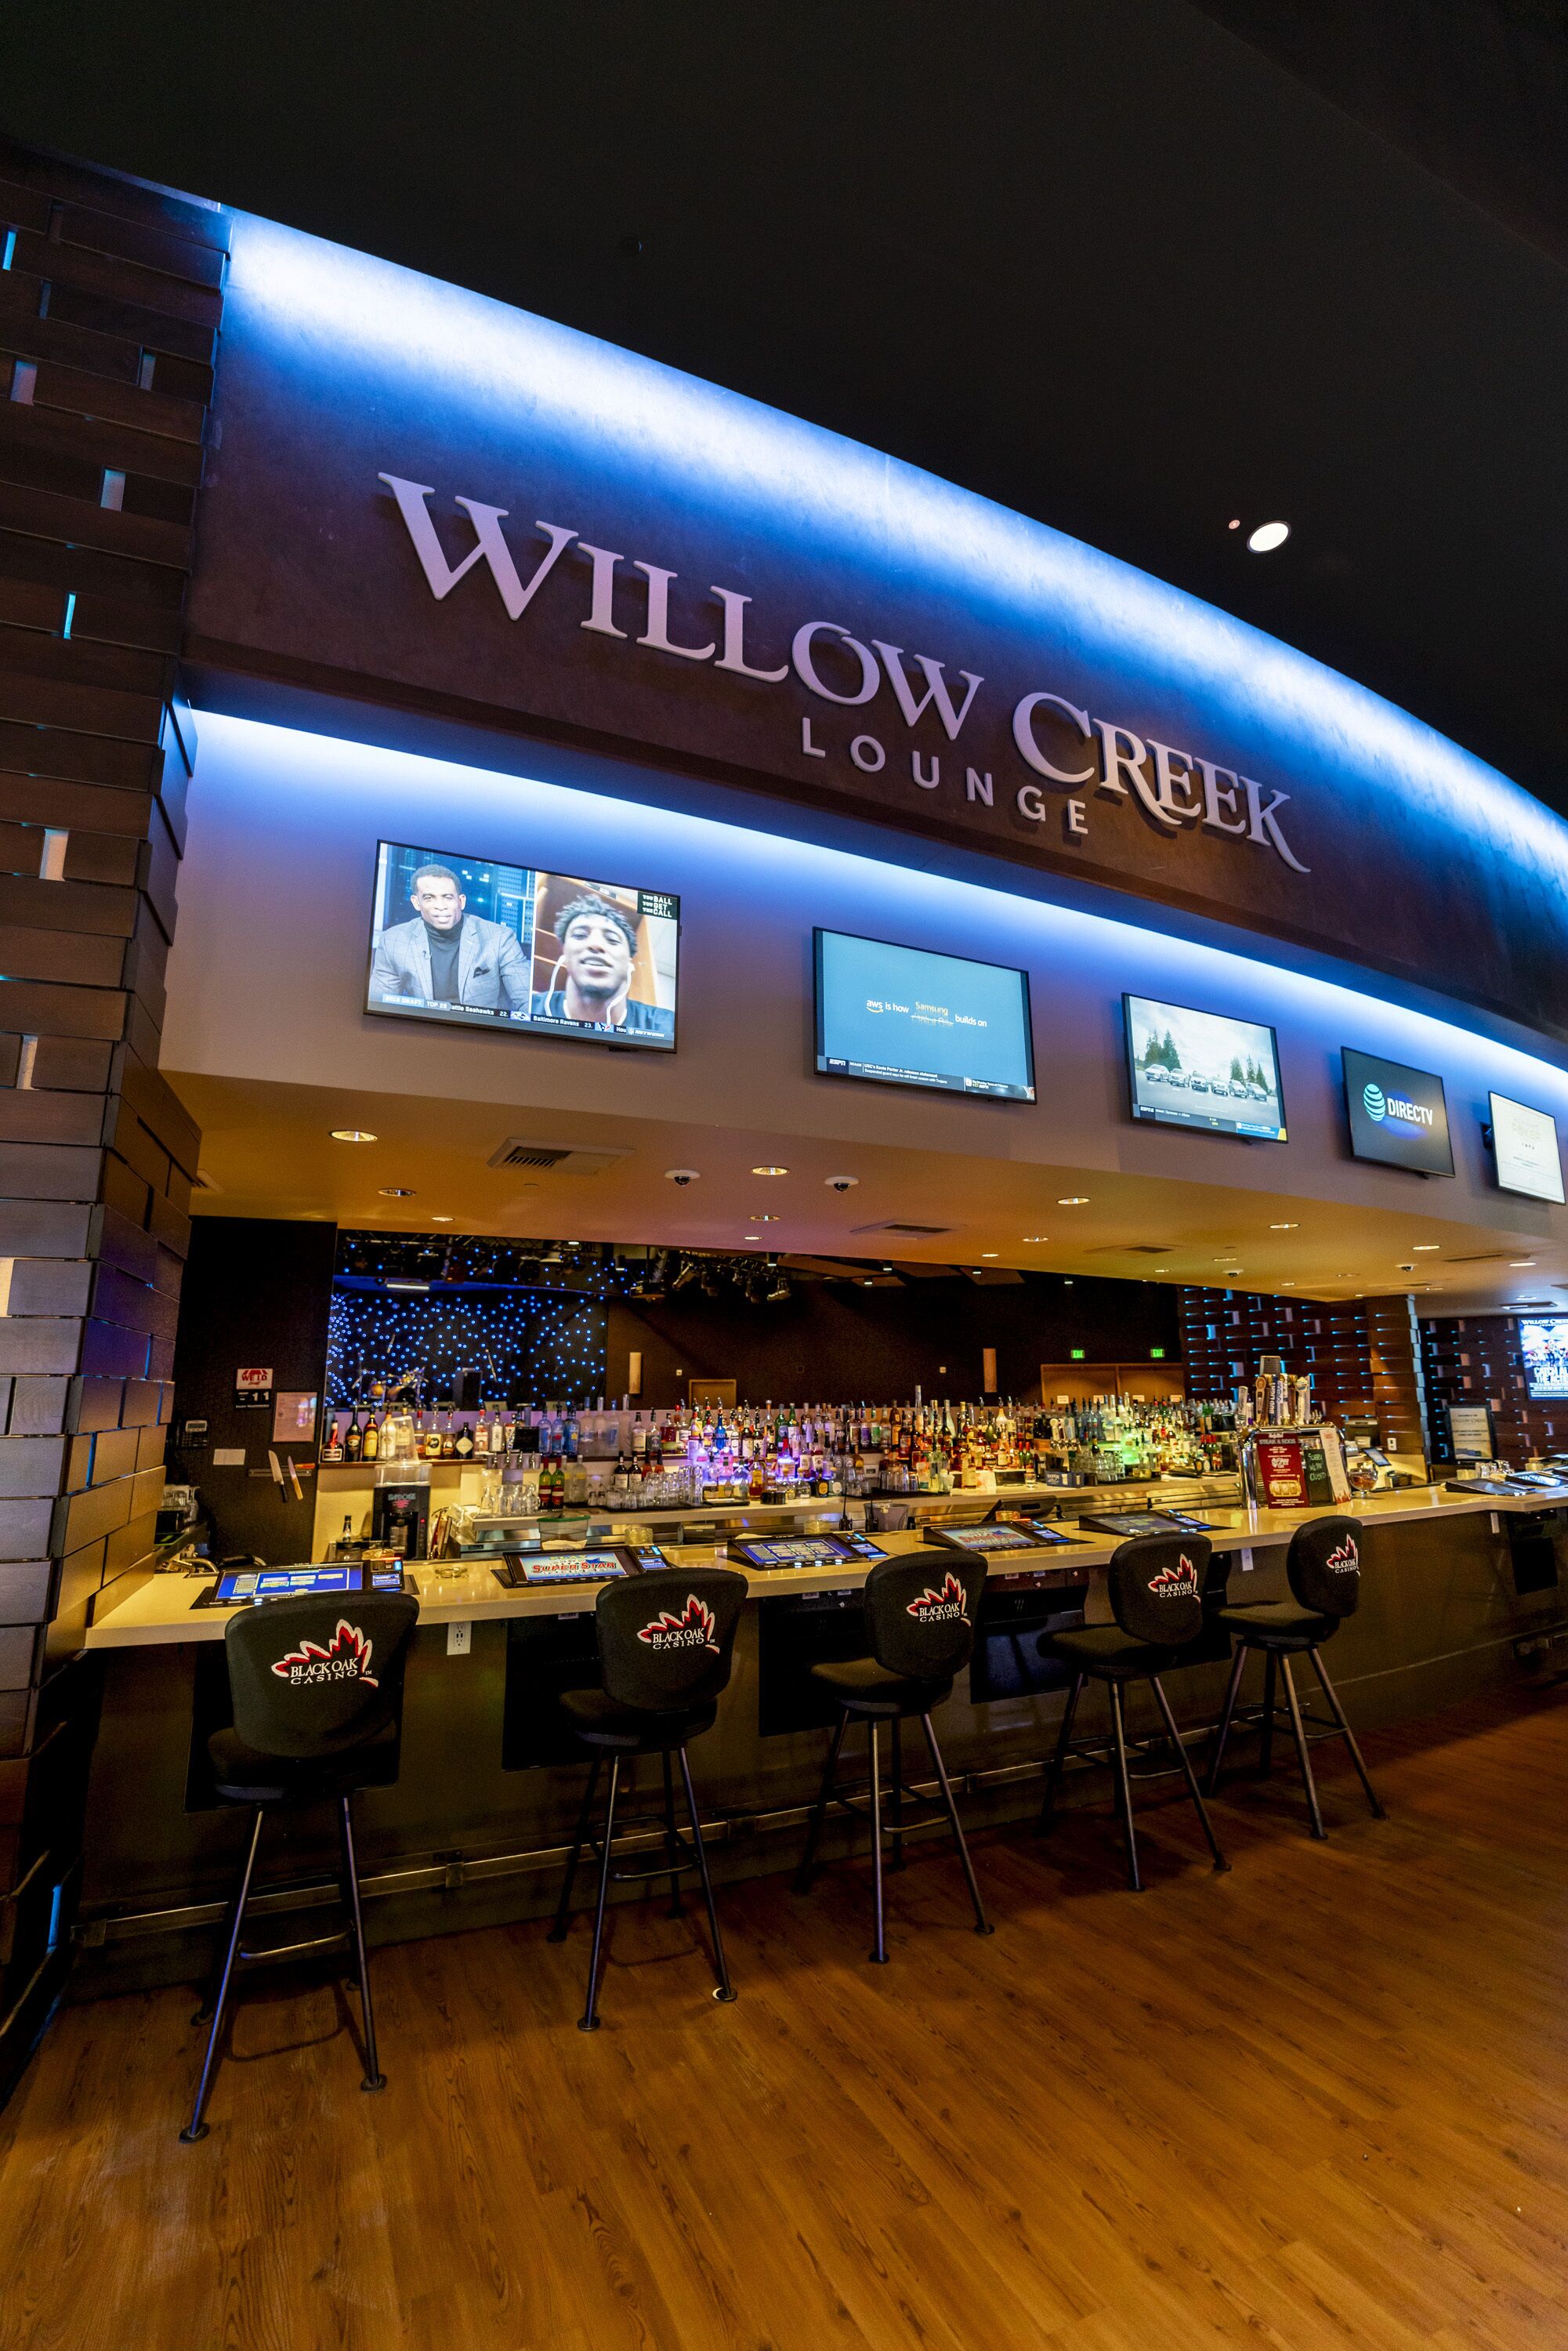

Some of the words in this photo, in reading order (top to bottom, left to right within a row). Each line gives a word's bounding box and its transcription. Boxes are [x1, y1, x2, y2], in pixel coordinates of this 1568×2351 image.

[378, 472, 986, 741] WILLOW
[1012, 692, 1311, 873] CREEK
[802, 717, 1089, 835] LOUNGE
[654, 896, 672, 905] BALL
[654, 908, 672, 918] CALL
[465, 1005, 494, 1016] Seahawks
[885, 1002, 892, 1010] is
[893, 1002, 909, 1013] how
[954, 1014, 977, 1026] builds
[533, 1014, 559, 1025] Baltimore
[559, 1018, 579, 1027] Ravens
[1387, 1097, 1432, 1126] DIRECTV
[533, 1563, 578, 1573] SUPER
[581, 1561, 616, 1570] STAR
[1334, 1565, 1356, 1574] CASINO
[1159, 1582, 1179, 1592] BLACK
[1179, 1581, 1193, 1591] OAK
[1159, 1588, 1193, 1598] CASINO
[918, 1604, 944, 1617] BLACK
[944, 1602, 960, 1613] OAK
[919, 1611, 960, 1622] CASINO
[652, 1630, 684, 1643] BLACK
[684, 1628, 705, 1639] OAK
[652, 1637, 704, 1650] CASINO
[290, 1661, 331, 1678] BLACK
[331, 1657, 360, 1672] OAK
[290, 1669, 358, 1685] CASINO
